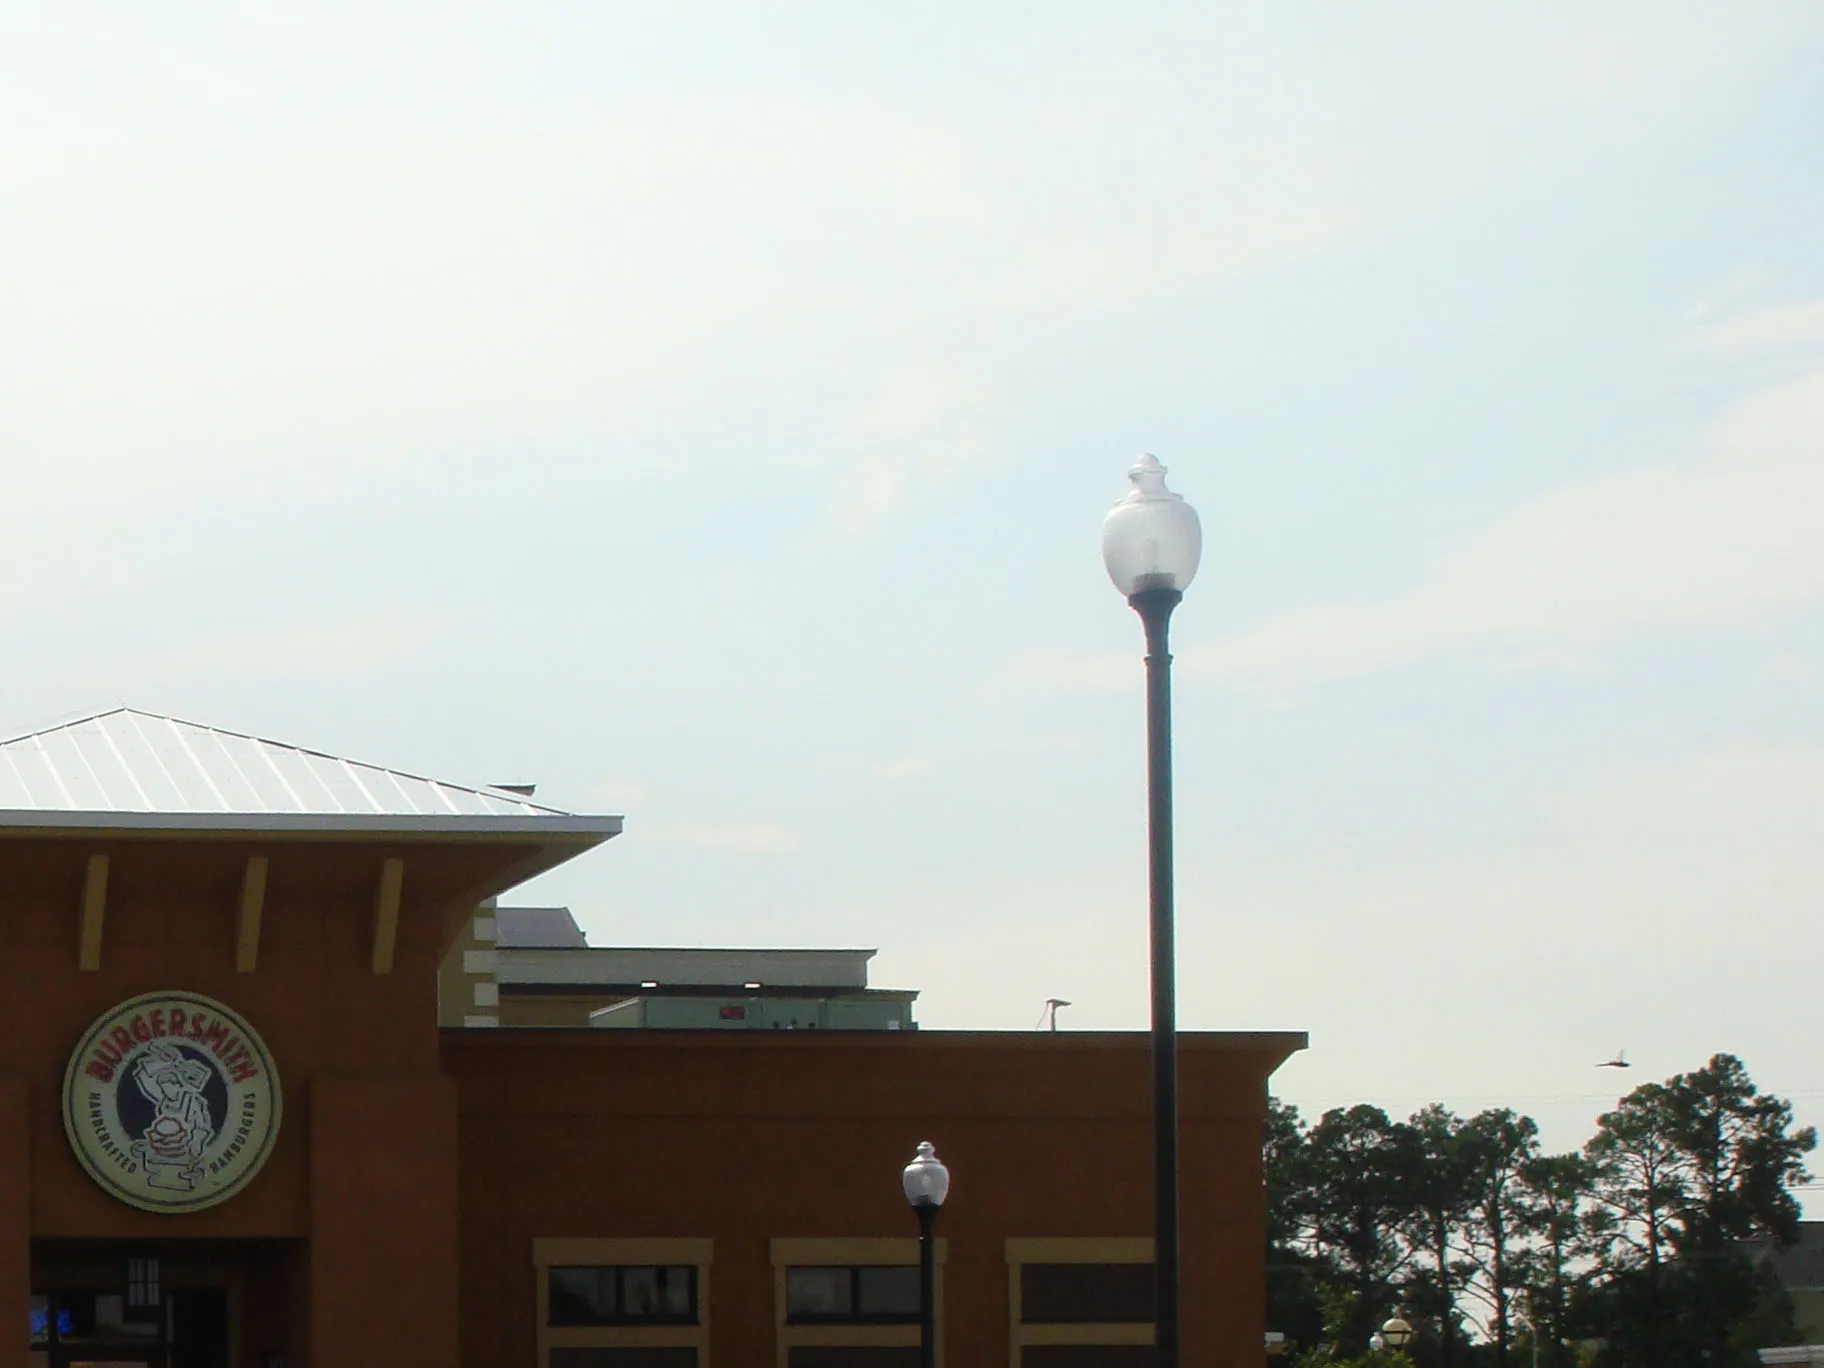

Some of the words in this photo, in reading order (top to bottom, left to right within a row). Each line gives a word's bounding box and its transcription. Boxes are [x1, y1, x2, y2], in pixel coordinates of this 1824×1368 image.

[84, 1008, 259, 1085] BURGERSMITH
[88, 1092, 138, 1175] HANDCRAFTED
[208, 1092, 256, 1175] HAMBURGERS
